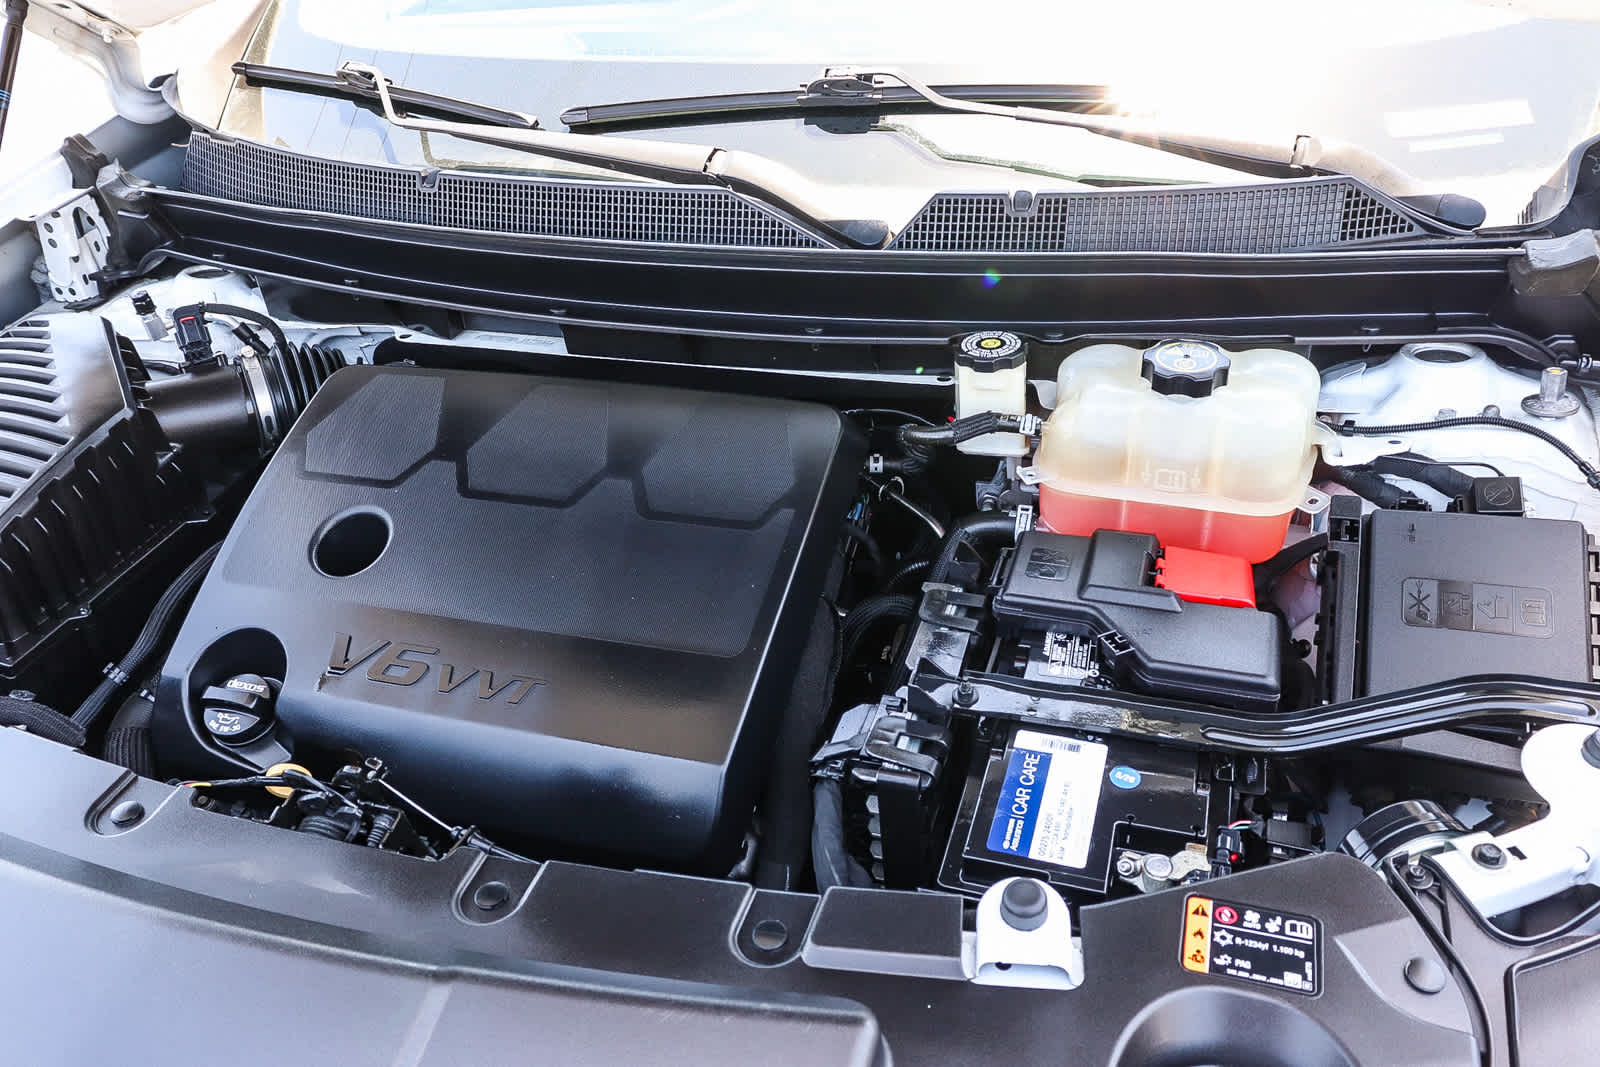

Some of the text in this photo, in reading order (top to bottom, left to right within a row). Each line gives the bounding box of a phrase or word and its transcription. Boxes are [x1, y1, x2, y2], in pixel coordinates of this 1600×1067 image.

[226, 679, 266, 693] dexos
[326, 632, 548, 704] V6 VVT
[1011, 752, 1040, 815] CAR CARE
